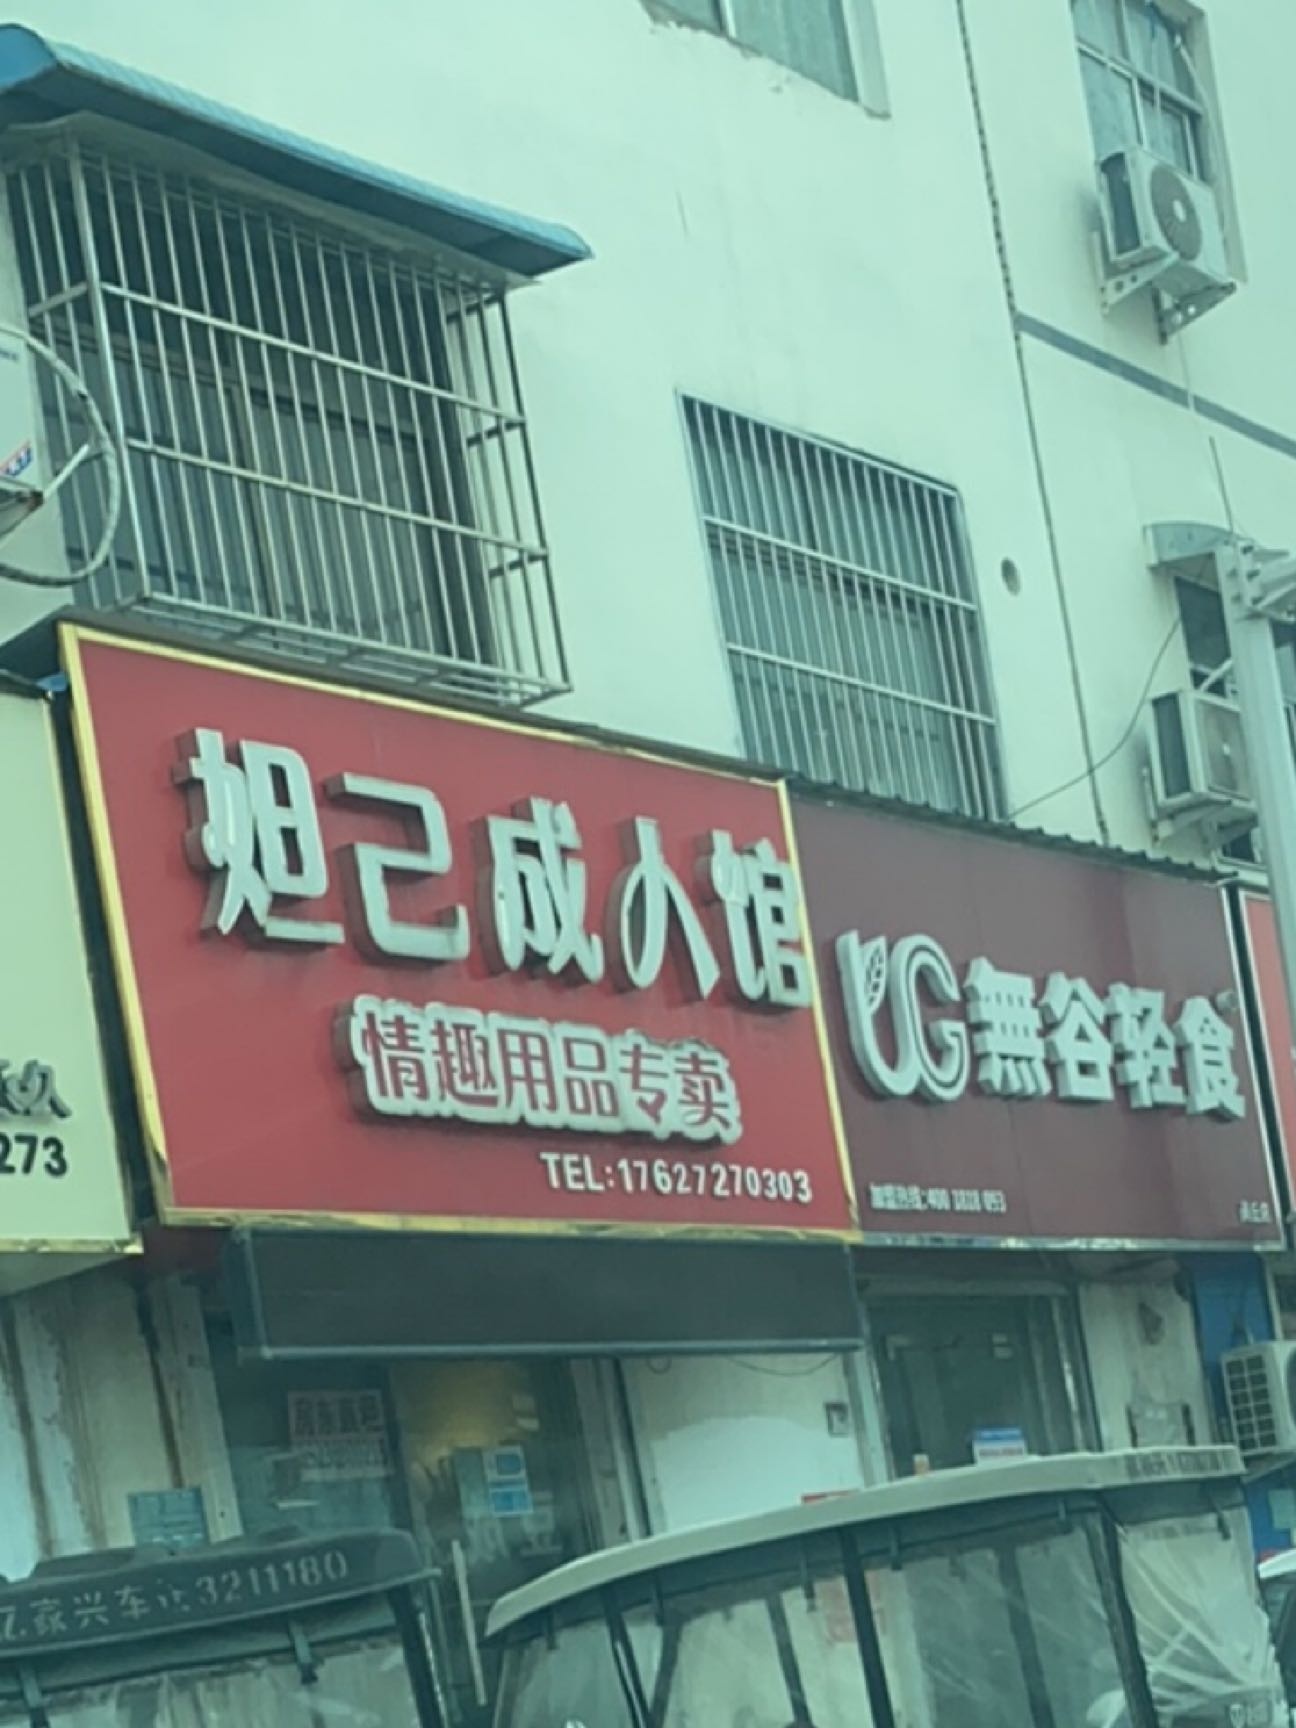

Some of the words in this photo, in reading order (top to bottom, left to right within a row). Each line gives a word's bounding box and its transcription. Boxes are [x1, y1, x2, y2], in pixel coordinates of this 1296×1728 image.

[180, 728, 812, 1009] 妲己成人馆
[356, 1004, 737, 1138] 情趣用品专卖
[540, 1151, 813, 1204] TEL:17627270303
